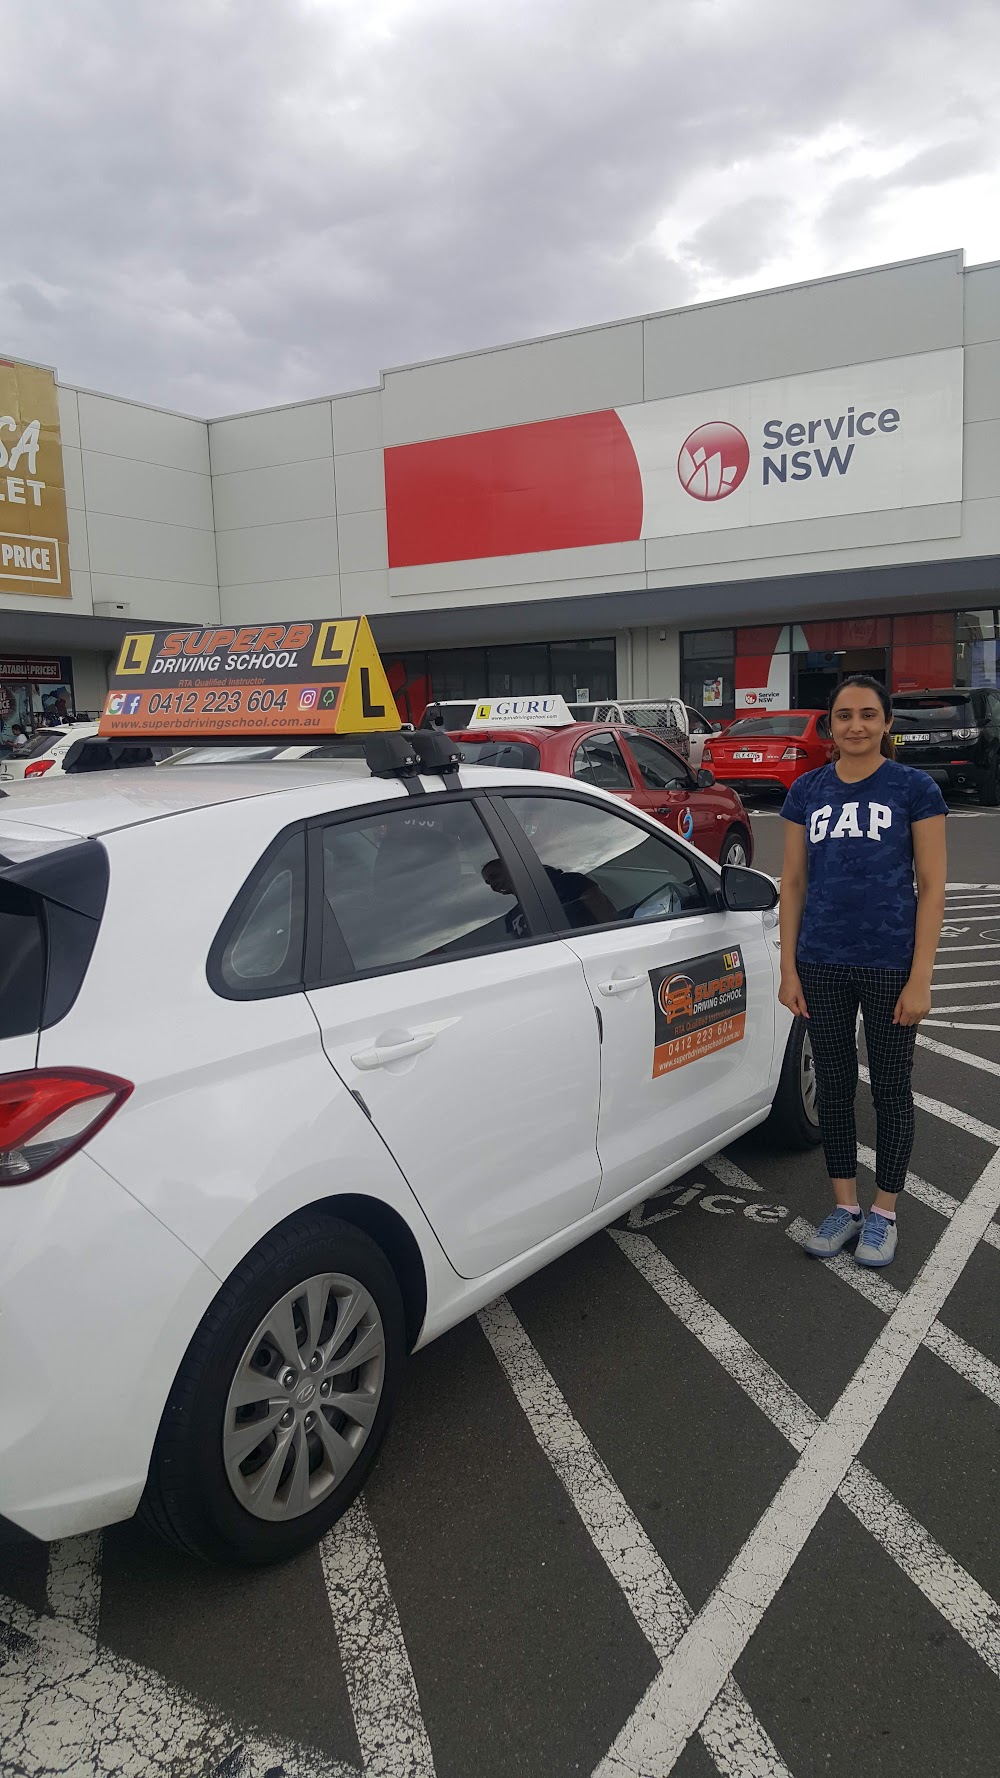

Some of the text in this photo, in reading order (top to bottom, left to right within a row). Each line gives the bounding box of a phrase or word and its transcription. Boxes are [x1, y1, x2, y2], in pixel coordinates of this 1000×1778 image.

[763, 406, 900, 450] Service
[763, 444, 855, 485] NSW
[0, 476, 46, 506] ET
[2, 543, 50, 571] PRICE
[123, 638, 142, 670] L
[156, 623, 314, 657] SUPERB
[321, 625, 344, 660] L
[150, 652, 299, 674] DRIVING SCHOOL
[178, 677, 266, 688] RTA Qualified Instructor
[360, 667, 386, 718] L
[148, 689, 289, 715] 0412 223 604
[480, 699, 556, 716] L GURU
[111, 716, 321, 730] www.superbdrivingschool.com.au
[810, 801, 892, 843] GAP
[724, 952, 739, 969] L P
[693, 971, 744, 1003] SUPERB
[693, 988, 742, 1015] DRIVING SCHOOL
[668, 1019, 733, 1056] 0412 223 604
